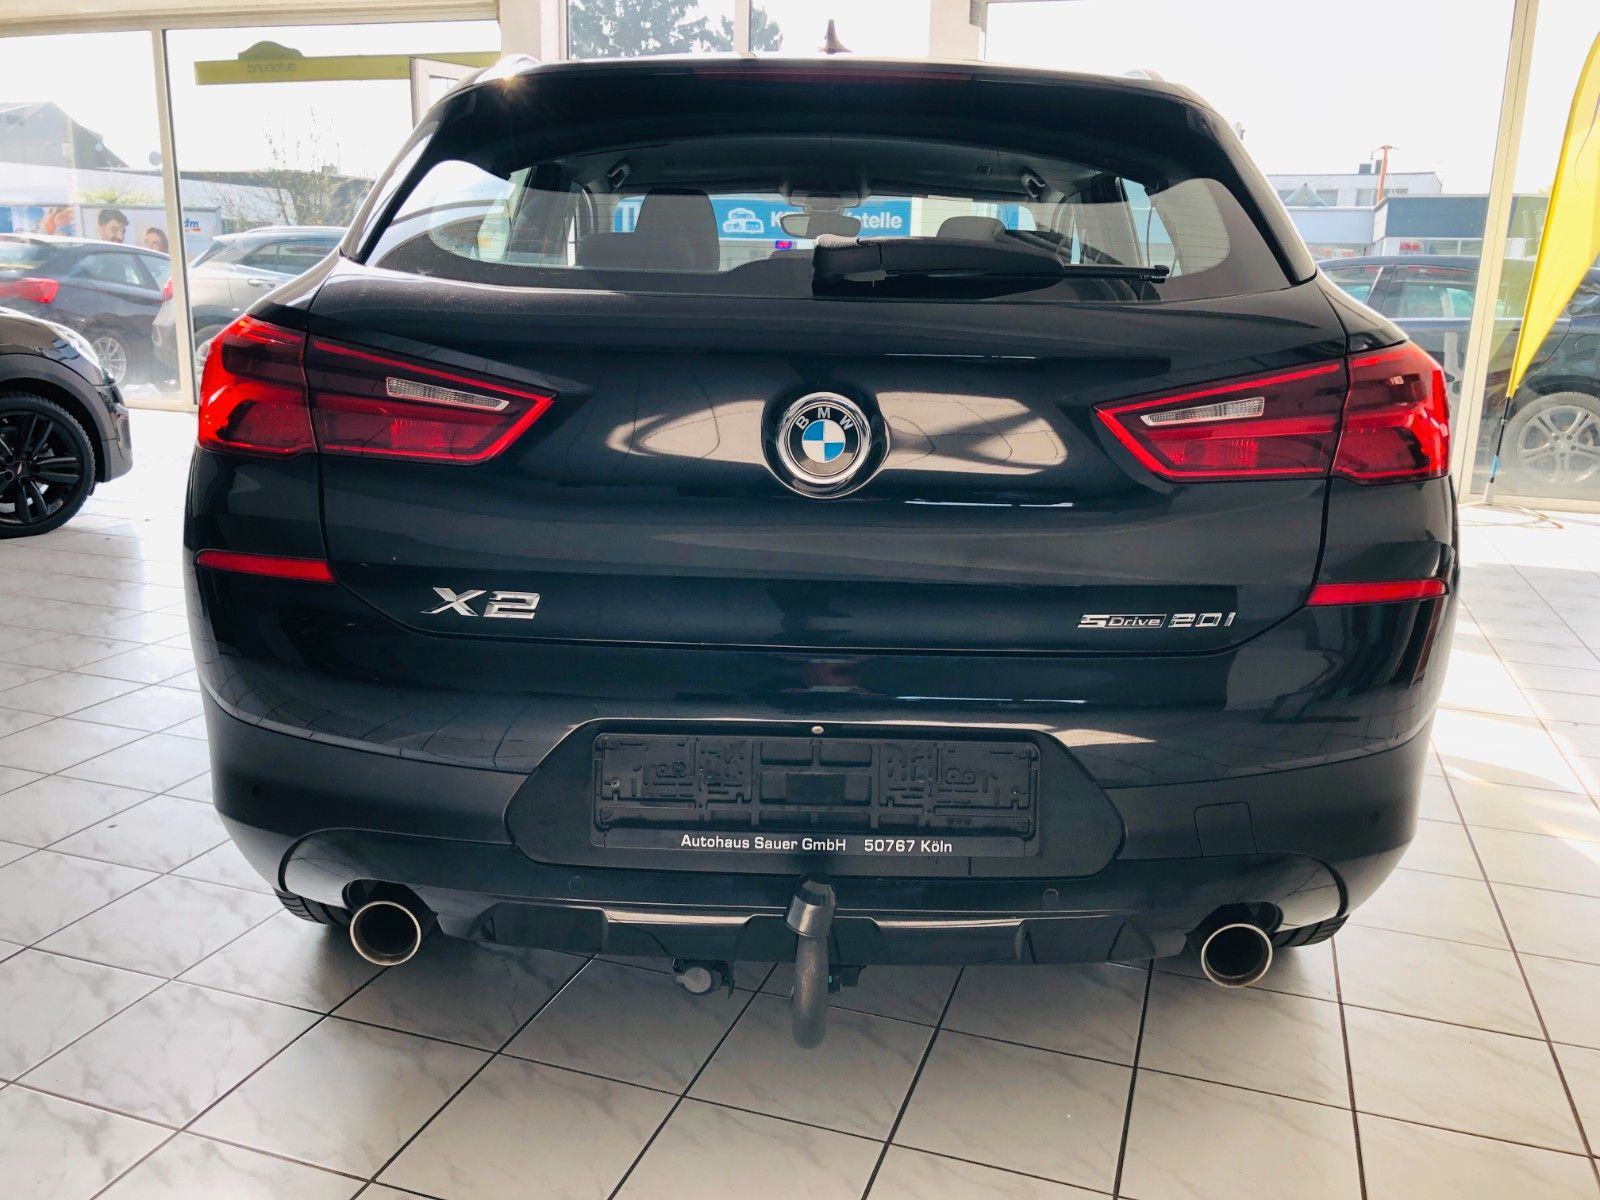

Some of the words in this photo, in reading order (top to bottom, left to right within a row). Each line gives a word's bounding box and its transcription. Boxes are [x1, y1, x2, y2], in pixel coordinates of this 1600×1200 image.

[796, 407, 854, 430] BMW
[421, 587, 541, 619] X2
[681, 834, 750, 848] Autohaus
[754, 837, 798, 850] Sauer
[802, 838, 846, 851] GmbH
[864, 839, 915, 852] 50767
[921, 839, 953, 853] Köln
